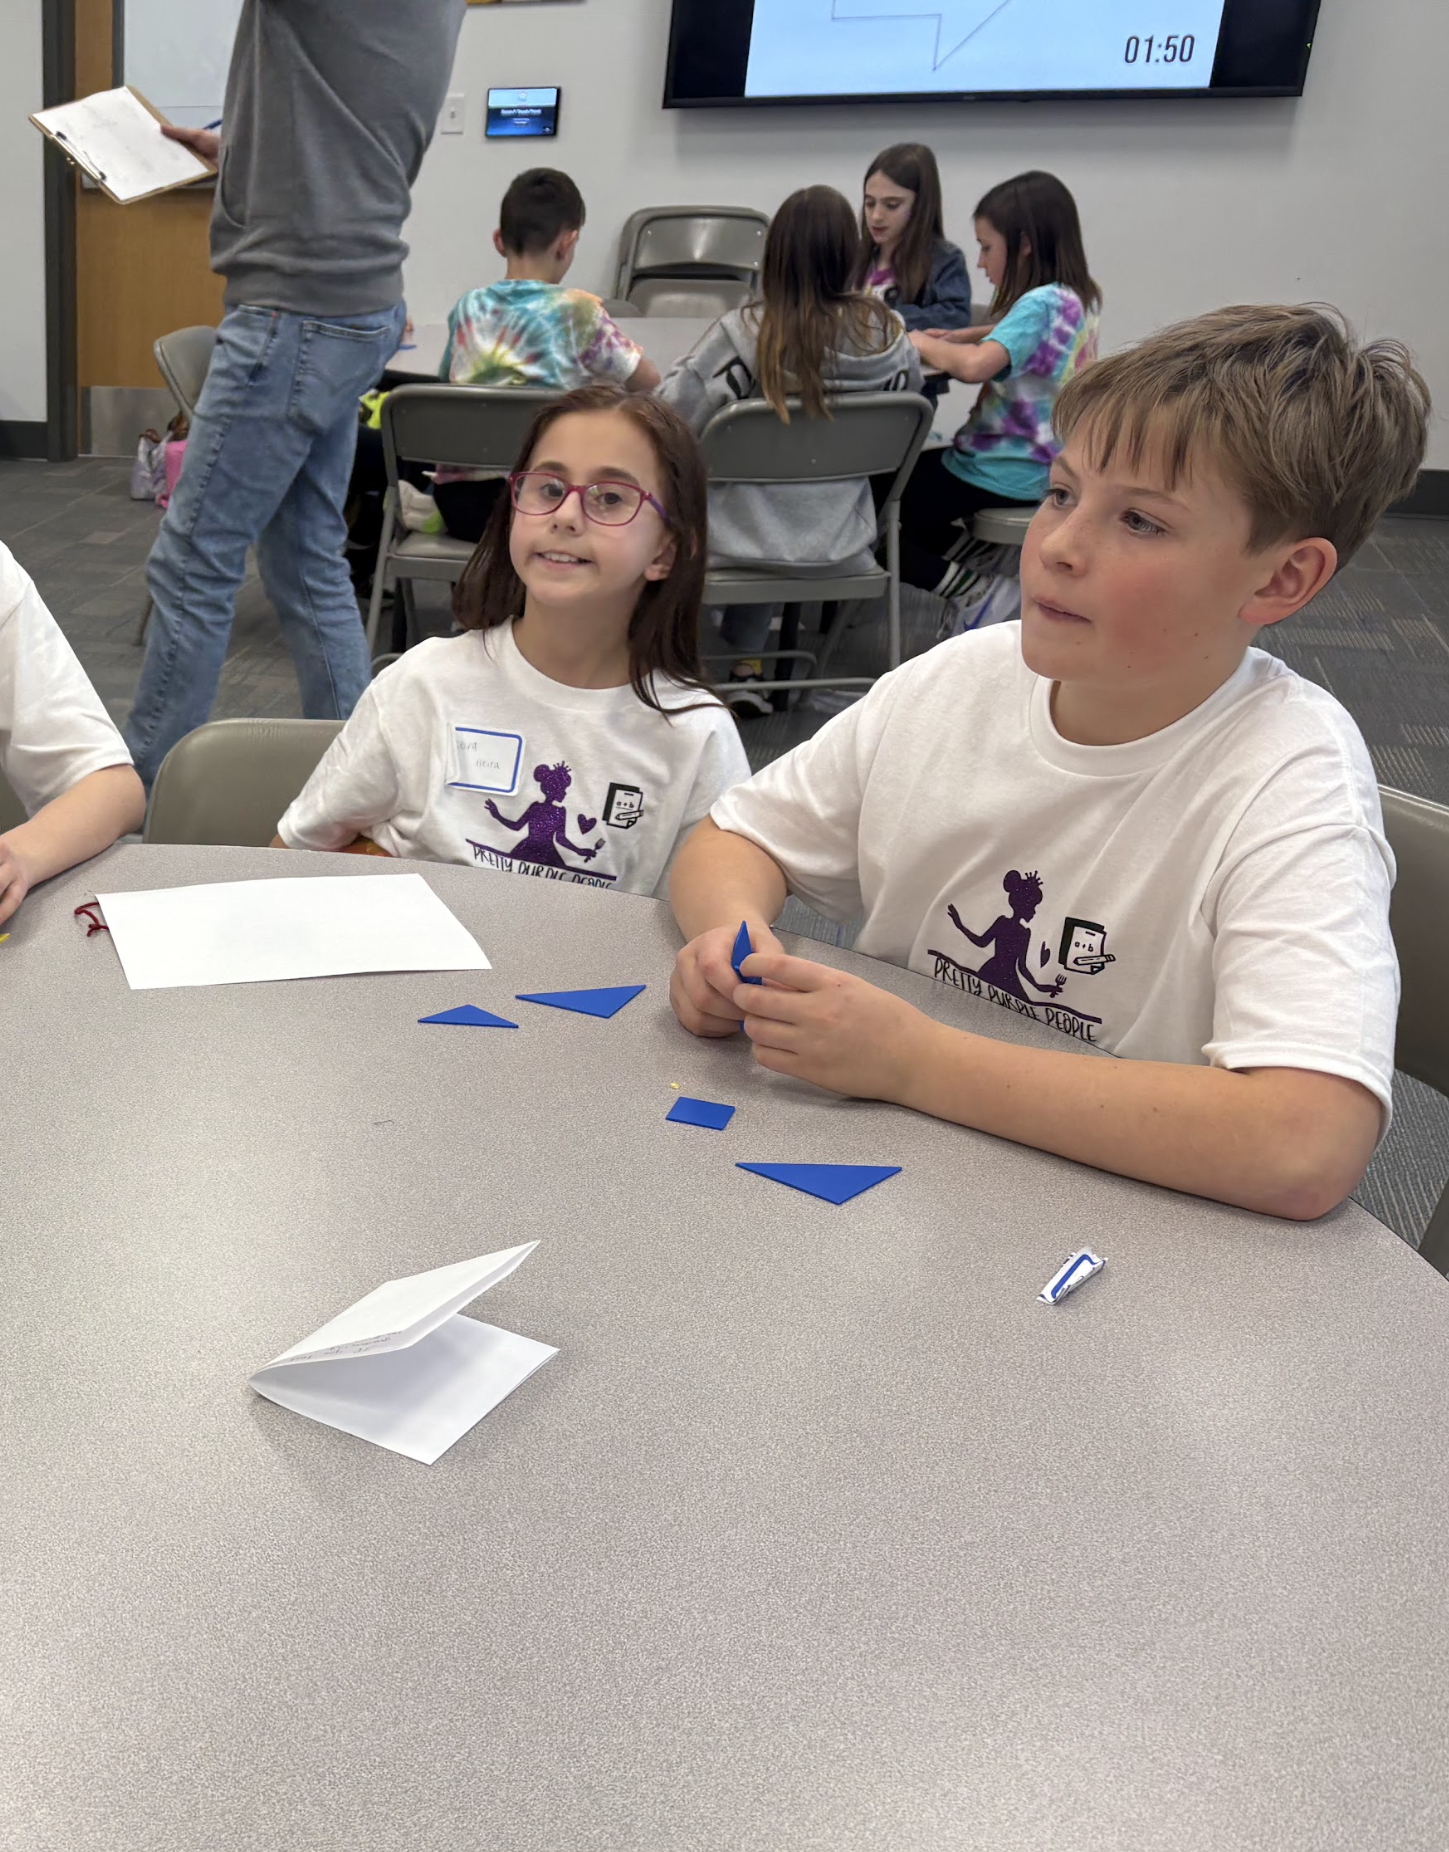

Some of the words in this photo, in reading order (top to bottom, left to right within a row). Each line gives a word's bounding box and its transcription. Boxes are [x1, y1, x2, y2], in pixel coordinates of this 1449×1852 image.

[1124, 34, 1196, 64] 01:50
[473, 845, 513, 872] PRETTY
[934, 957, 982, 996] PRETTY
[987, 984, 1041, 1021] PURPLE
[1045, 1007, 1098, 1042] PEOPLE
